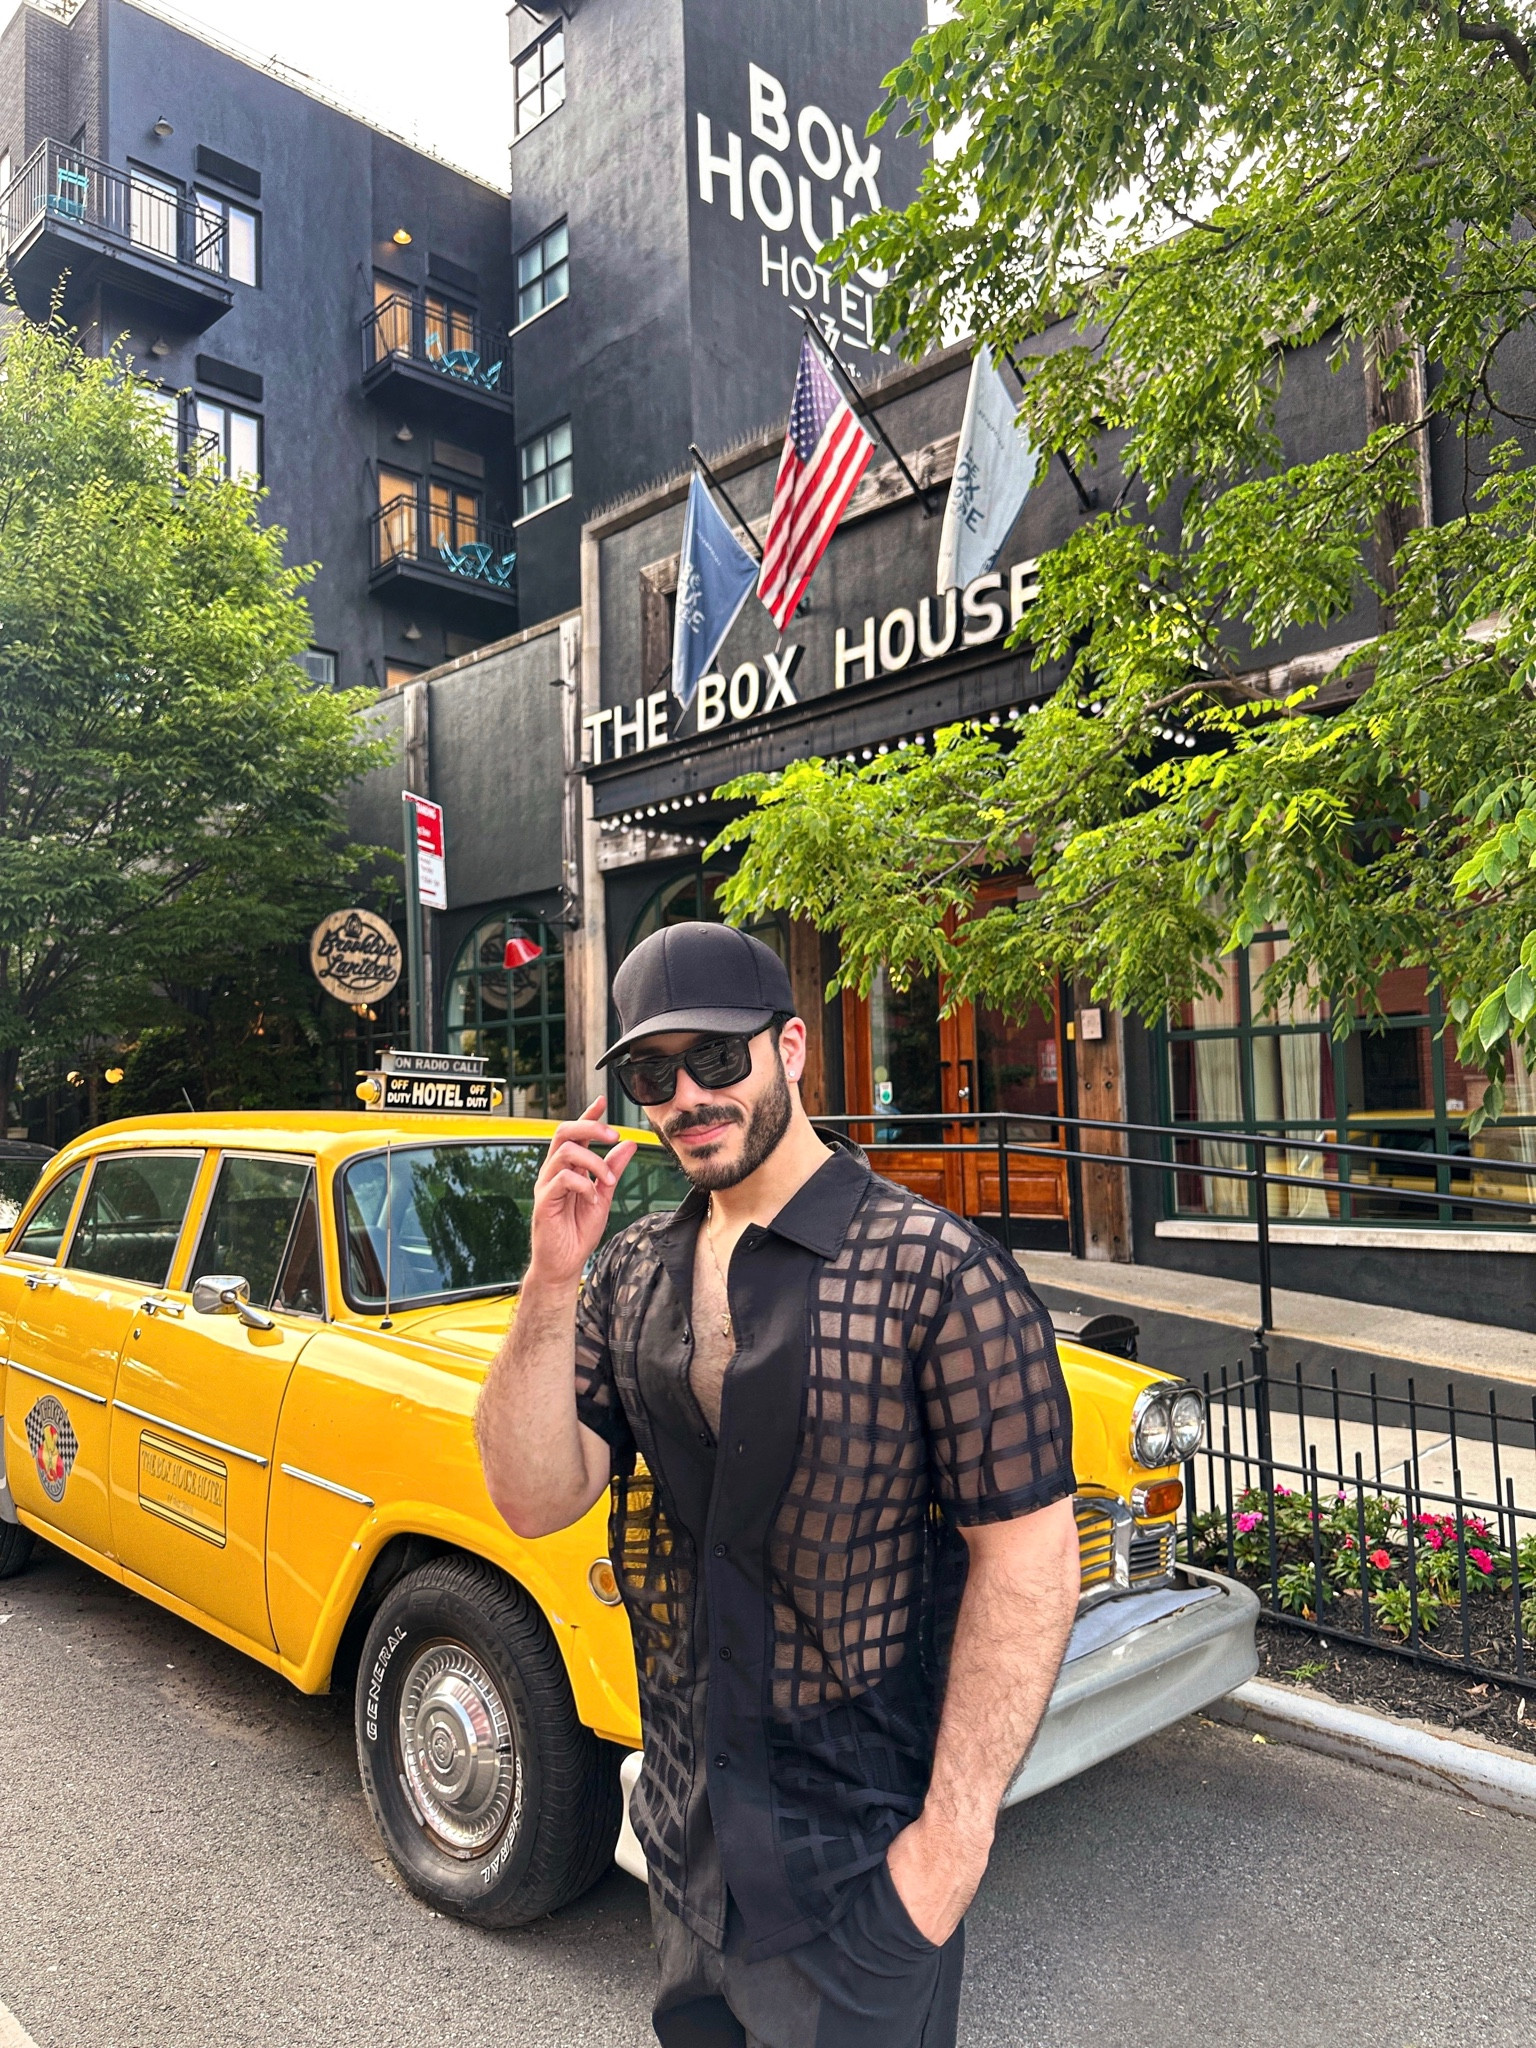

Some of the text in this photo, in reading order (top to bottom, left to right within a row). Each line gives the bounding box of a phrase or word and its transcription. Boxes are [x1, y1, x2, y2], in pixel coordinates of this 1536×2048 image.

[749, 62, 882, 215] BOX
[582, 690, 669, 765] THE
[697, 645, 799, 731] BOX
[318, 929, 398, 961] Brooklyn
[319, 953, 398, 982] Lantern
[395, 1057, 480, 1074] ON RADIO CALL
[387, 1091, 412, 1104] DUTY
[390, 1079, 410, 1091] OFF
[411, 1081, 464, 1108] HOTEL
[469, 1084, 487, 1095] OFF
[466, 1096, 488, 1109] DUTY
[366, 1625, 408, 1741] GENERAL
[480, 1756, 523, 1883] GENERAL
